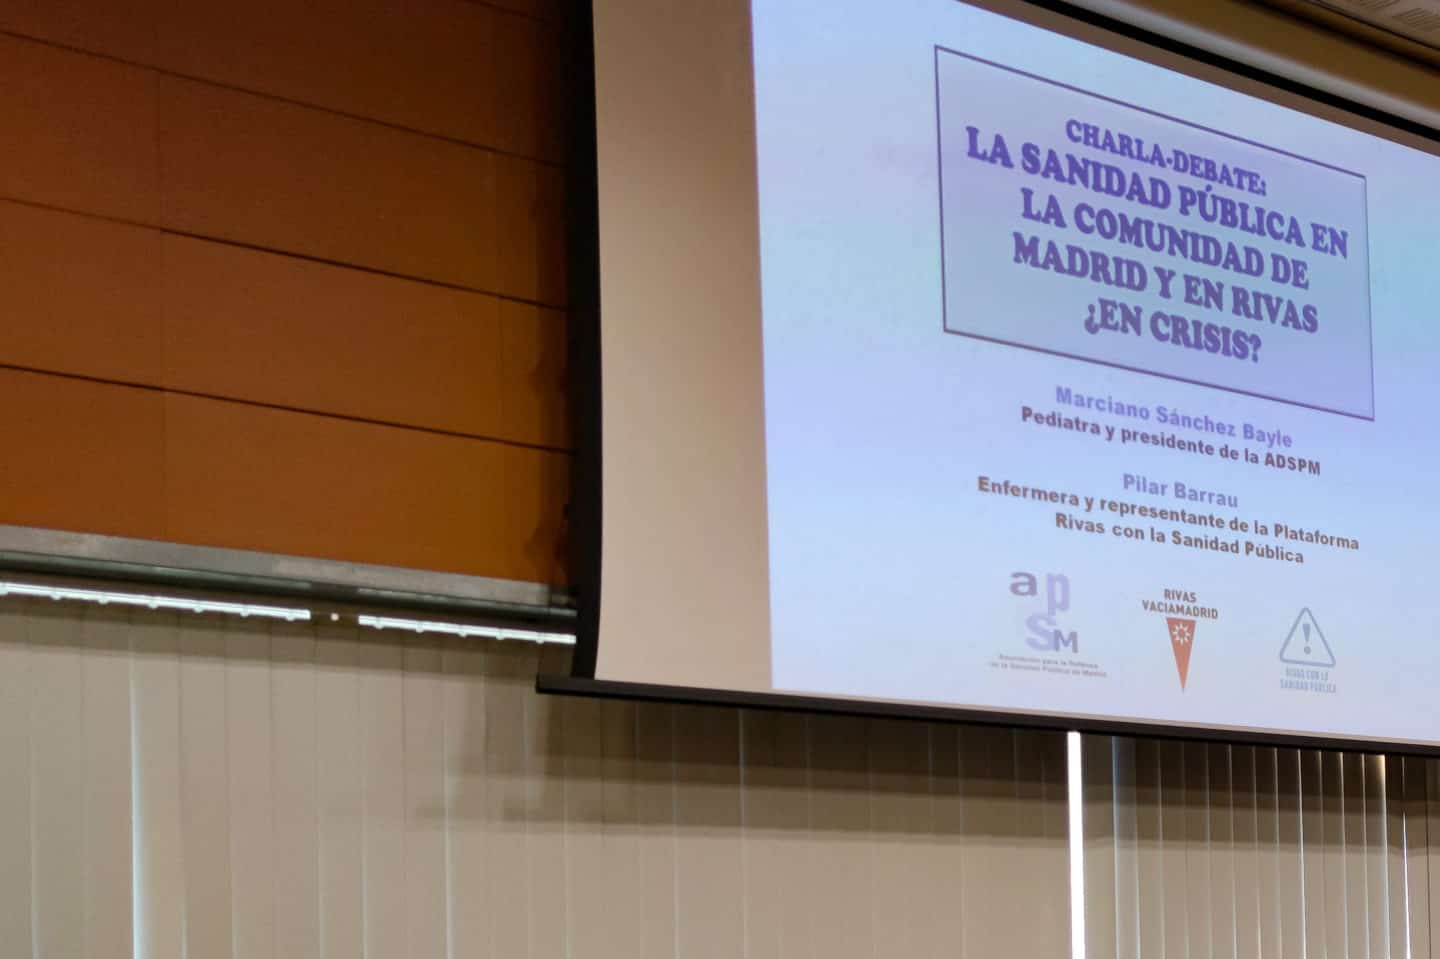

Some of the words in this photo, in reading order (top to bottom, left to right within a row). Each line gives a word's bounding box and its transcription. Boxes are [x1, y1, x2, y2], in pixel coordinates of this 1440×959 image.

[1066, 119, 1267, 196] CHARLA-DEBATE:
[966, 126, 1014, 169] LA
[1022, 142, 1171, 210] SANIDAD
[1178, 184, 1306, 248] PÚBLICA
[1311, 221, 1348, 259] EN
[1021, 188, 1067, 229] LA
[1074, 202, 1264, 277] COMUNIDAD
[1270, 255, 1309, 290] DE
[1012, 232, 1147, 292] MADRID
[1152, 267, 1177, 298] Y
[1183, 276, 1224, 310] EN
[1231, 286, 1318, 333] RIVAS
[1083, 297, 1143, 336] ¿EN
[1149, 311, 1262, 362] CRISIS?
[1021, 406, 1101, 436] Pediatra
[1105, 424, 1116, 441] y
[1121, 427, 1215, 457] presidente
[1219, 445, 1240, 460] de
[1244, 448, 1260, 465] la
[1264, 452, 1321, 476] ADSPM
[1055, 385, 1150, 421] Marciano
[1156, 406, 1237, 438] Sánchez
[1242, 423, 1293, 449] Bayle
[977, 476, 1080, 507] Enfermera
[1084, 496, 1095, 512] y
[1099, 498, 1225, 529] representante
[1228, 515, 1249, 533] de
[1254, 520, 1269, 536] la
[1273, 523, 1360, 551] Plataforma
[1122, 473, 1168, 498] Pilar
[1173, 482, 1239, 508] Barrau
[1054, 512, 1106, 534] Rivas
[1112, 525, 1145, 540] con
[1149, 527, 1166, 544] la
[1171, 530, 1240, 555] Sanidad
[1244, 538, 1304, 564] Pública
[1141, 600, 1219, 620] VACIAMADRID
[1163, 588, 1197, 603] RIVAS
